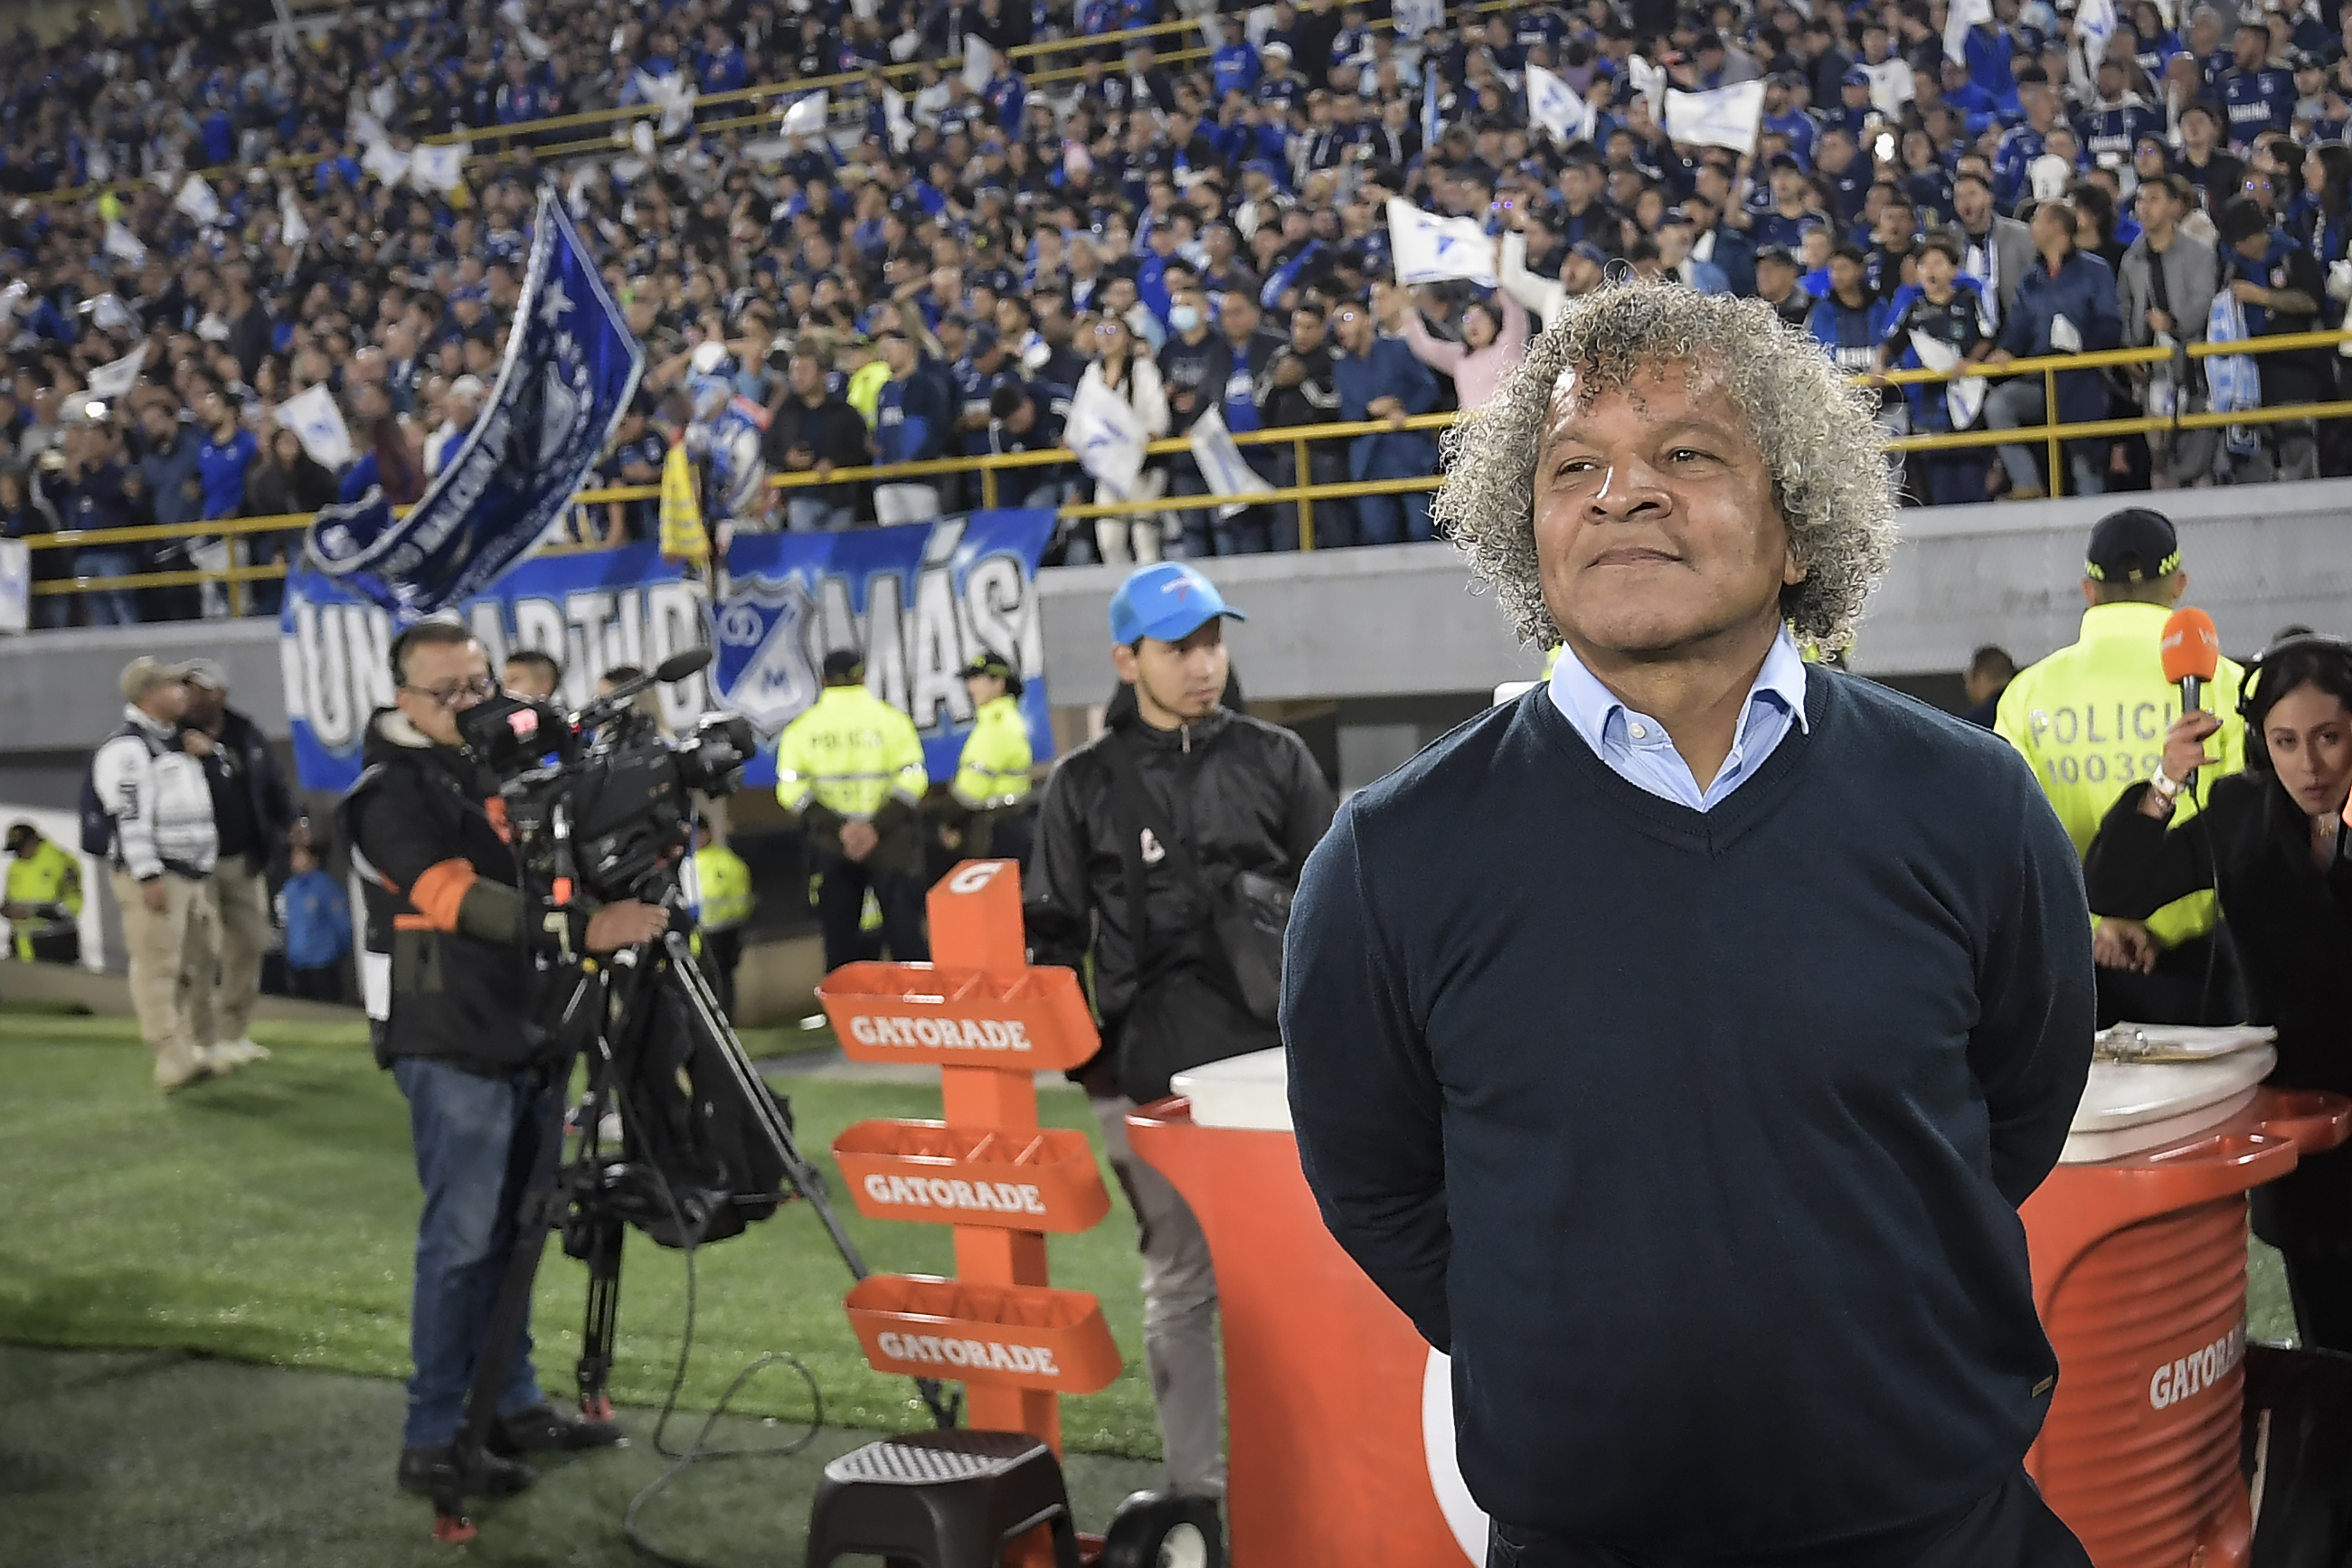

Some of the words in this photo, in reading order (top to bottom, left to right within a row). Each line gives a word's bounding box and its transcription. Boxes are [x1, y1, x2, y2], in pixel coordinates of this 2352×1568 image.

[298, 599, 397, 746] UN
[822, 515, 1020, 730] MÁS
[2028, 701, 2172, 748] POLICI
[2046, 752, 2162, 786] 10039
[949, 862, 1004, 894] G
[850, 1014, 1032, 1052] GATORADE
[864, 1173, 1047, 1215] GATORADE
[877, 1331, 1060, 1376] GATORADE
[2150, 1319, 2246, 1410] GATORA
